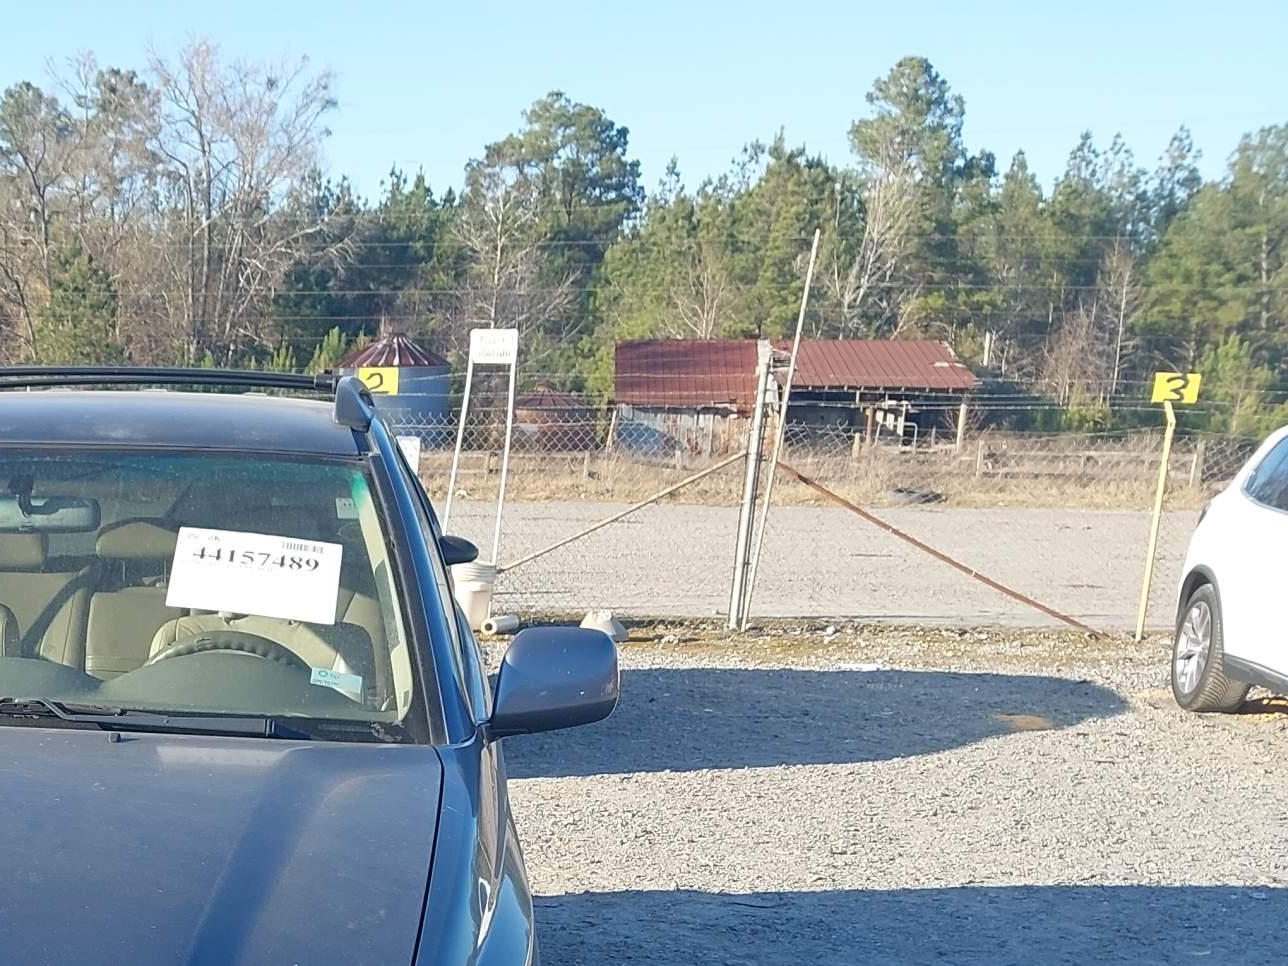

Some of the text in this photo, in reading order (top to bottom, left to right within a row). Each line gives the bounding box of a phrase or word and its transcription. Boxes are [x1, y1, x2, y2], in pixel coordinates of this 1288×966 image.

[365, 372, 389, 394] 2
[1163, 373, 1190, 402] 3
[192, 545, 321, 572] 44157489
